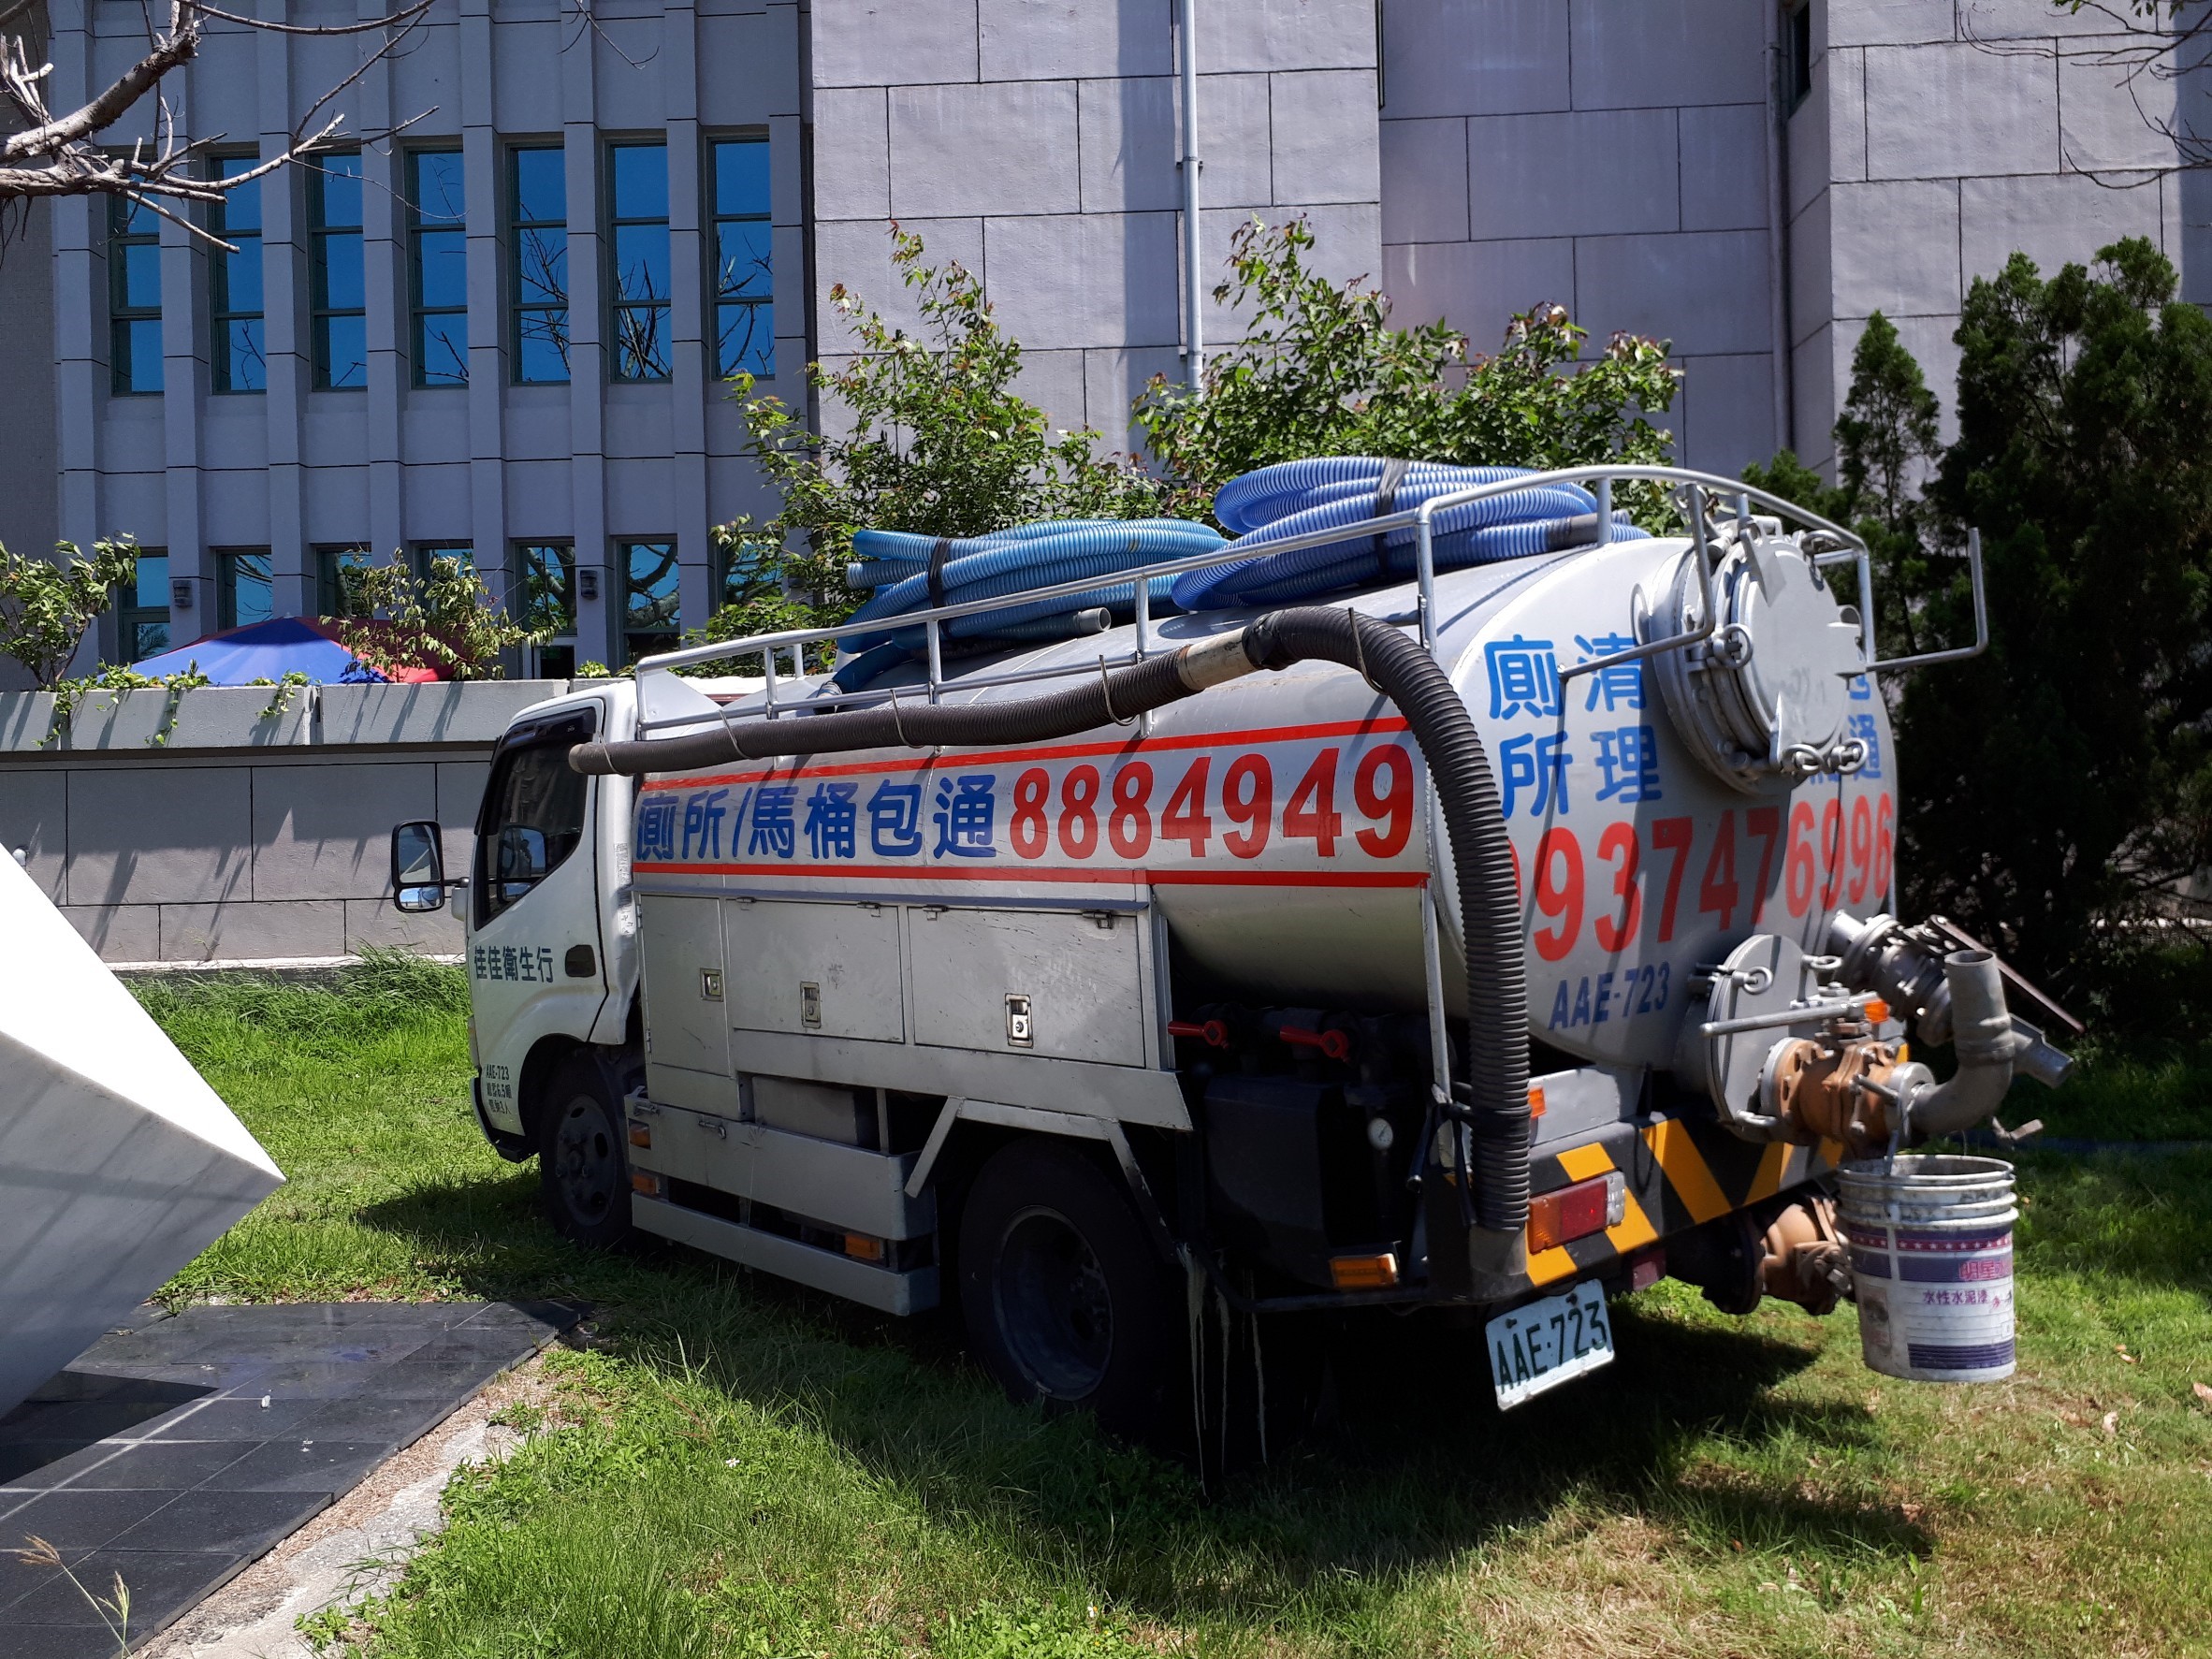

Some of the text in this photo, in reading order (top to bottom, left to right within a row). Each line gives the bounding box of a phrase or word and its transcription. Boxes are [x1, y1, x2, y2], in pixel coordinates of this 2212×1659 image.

[1009, 743, 1415, 859] 8884949
[1507, 792, 1894, 962] 937476996
[474, 945, 554, 982] 佳佳衛生行
[1548, 962, 1671, 1030] AAE-723
